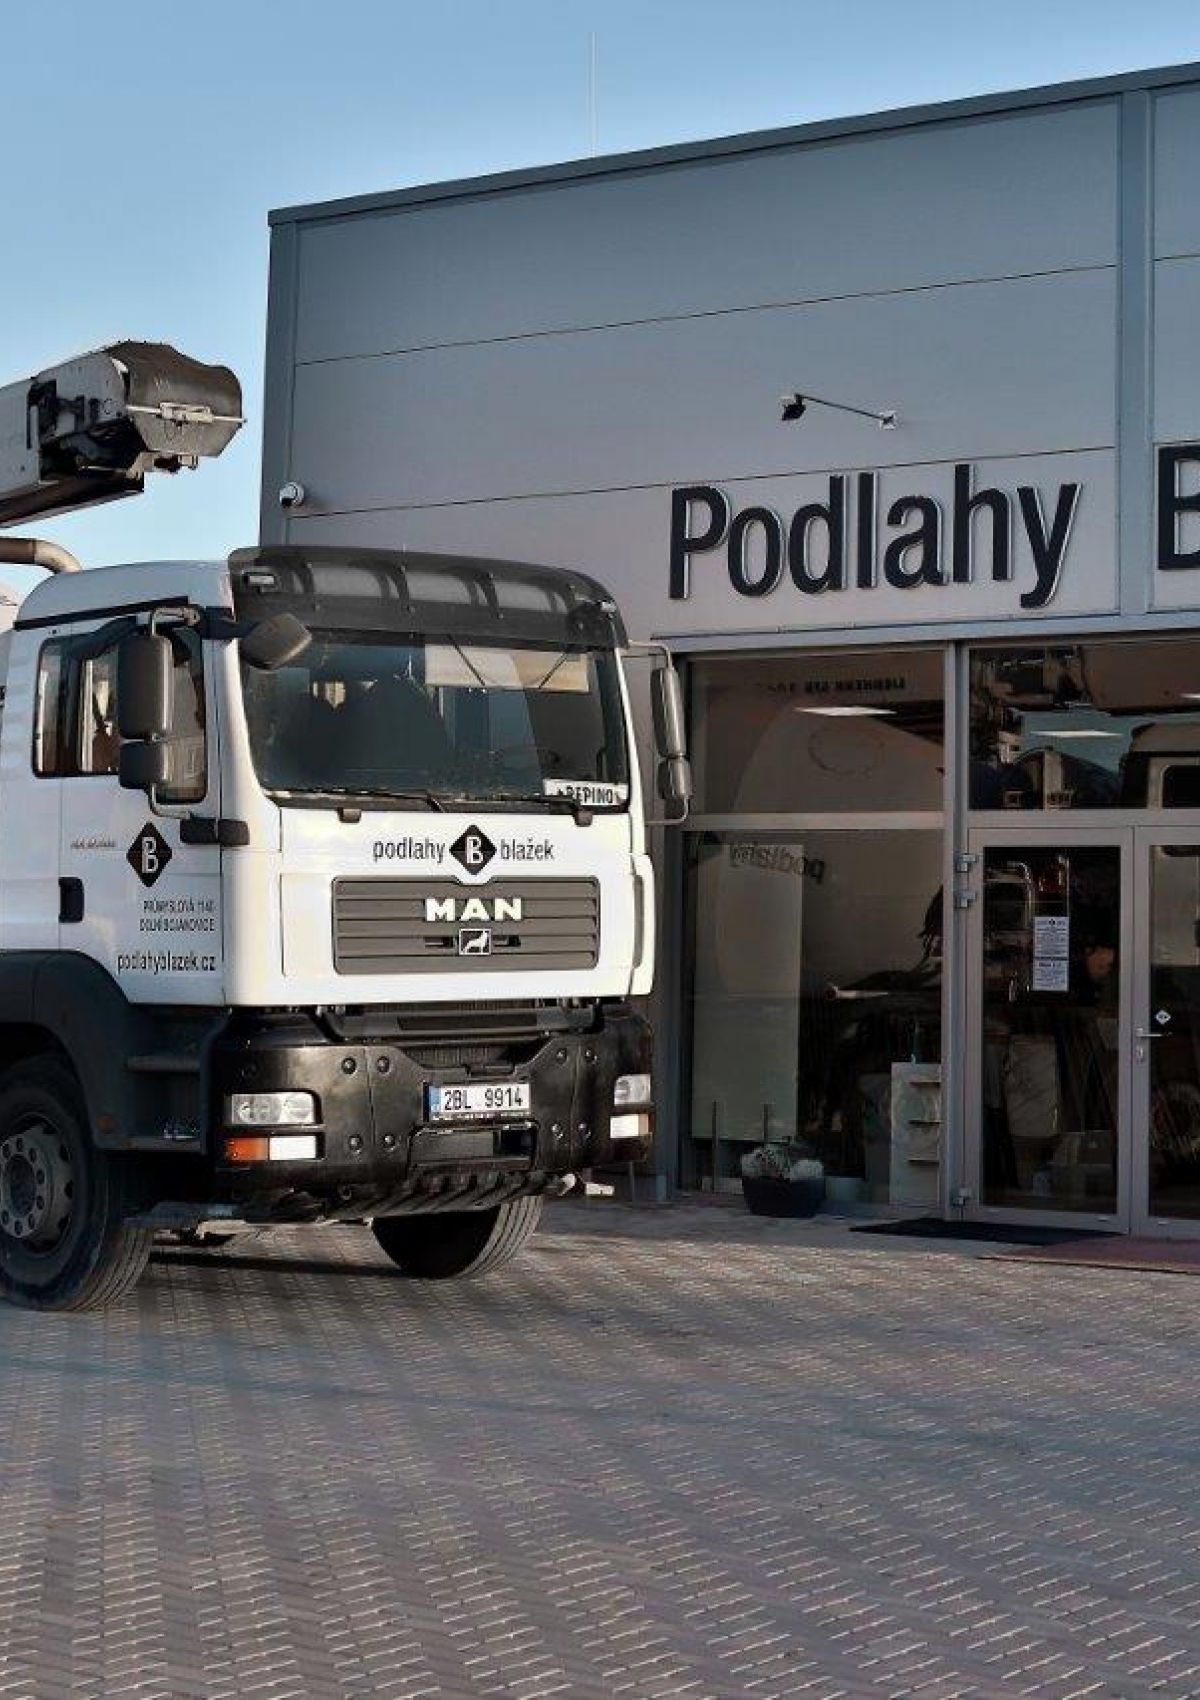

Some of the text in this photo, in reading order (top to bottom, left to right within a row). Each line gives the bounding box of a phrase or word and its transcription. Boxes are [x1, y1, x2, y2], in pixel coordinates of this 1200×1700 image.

[669, 463, 1081, 608] Podlahy
[372, 836, 446, 863] podlahy
[500, 837, 554, 861] blažek
[424, 898, 522, 921] MAN
[444, 1087, 524, 1110] 2BL 9914
